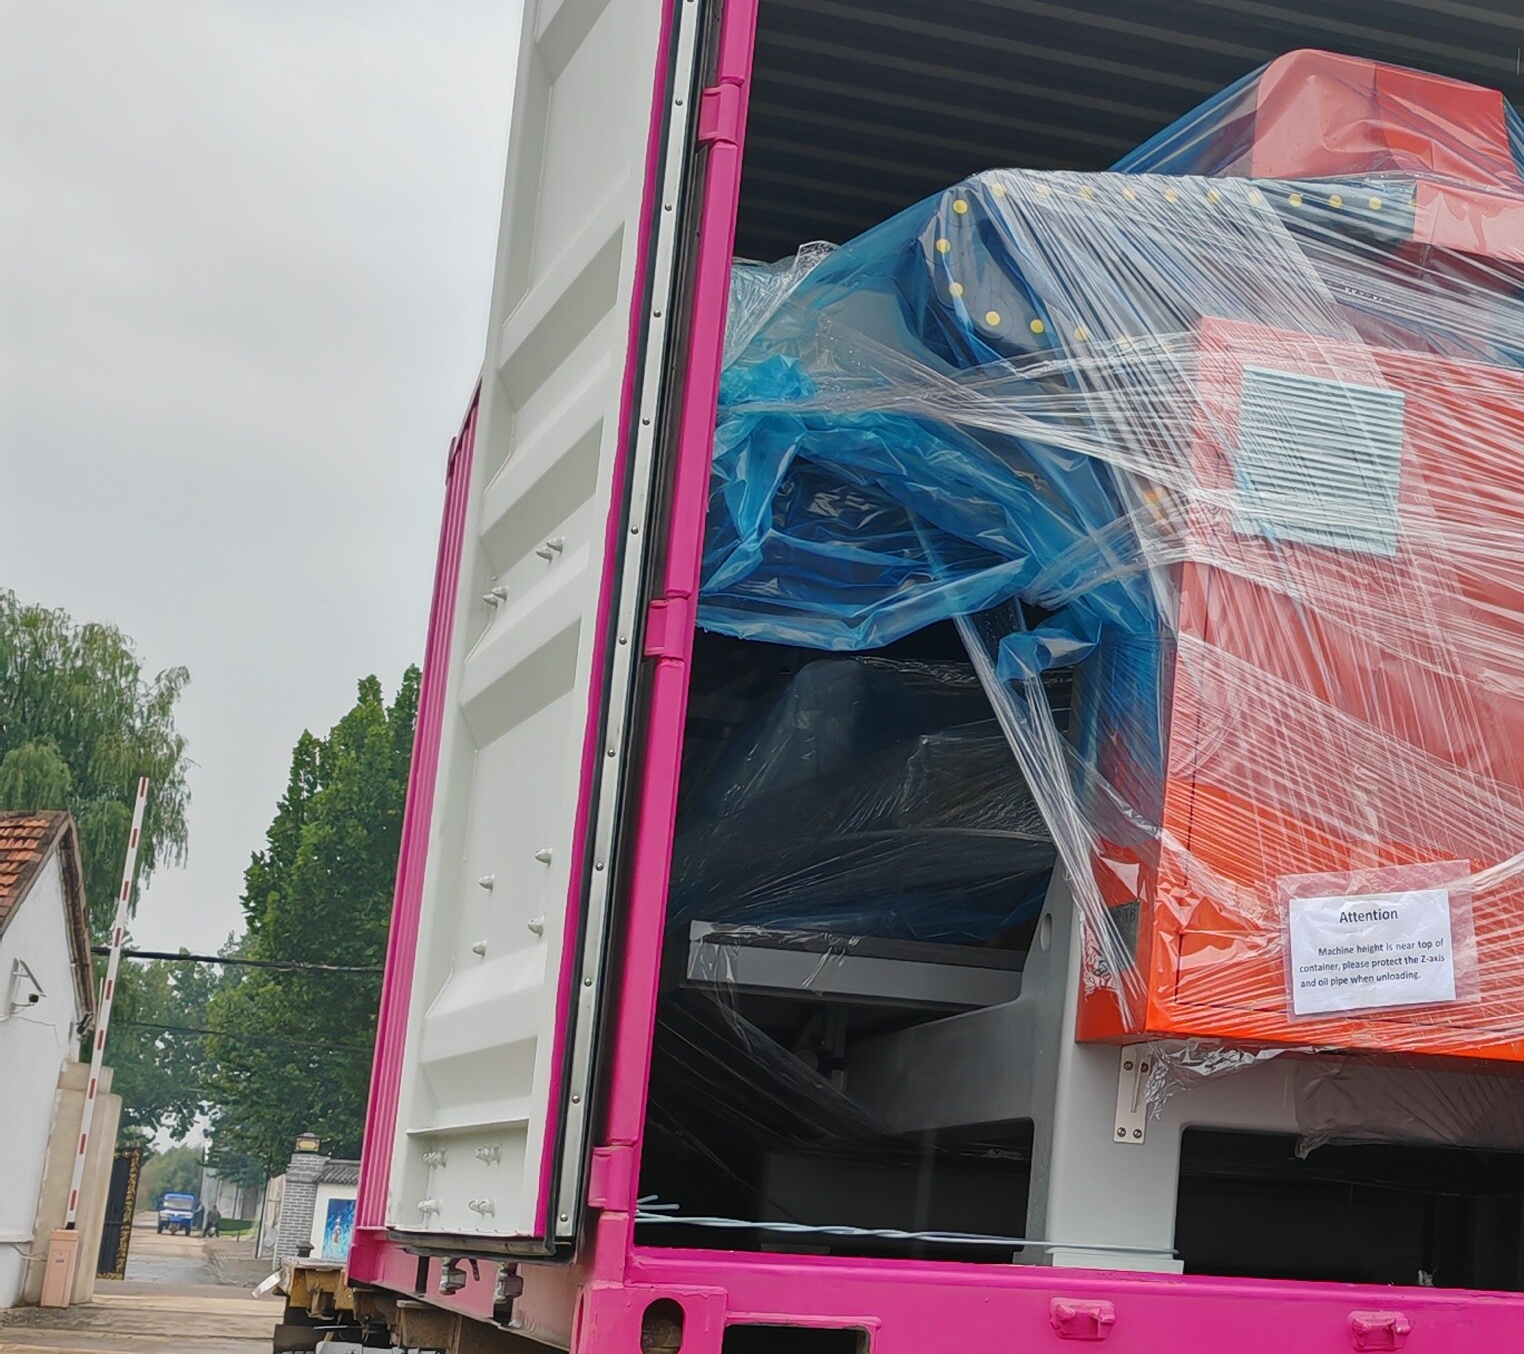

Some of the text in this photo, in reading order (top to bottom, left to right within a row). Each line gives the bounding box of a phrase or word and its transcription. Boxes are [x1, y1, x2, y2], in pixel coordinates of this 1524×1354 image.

[1339, 908, 1399, 924] Attention
[1318, 937, 1445, 957] Machine height is near top of
[1299, 953, 1446, 974] container, please protect the Z-axis
[1300, 970, 1422, 988] and oil pipe when unloading.
